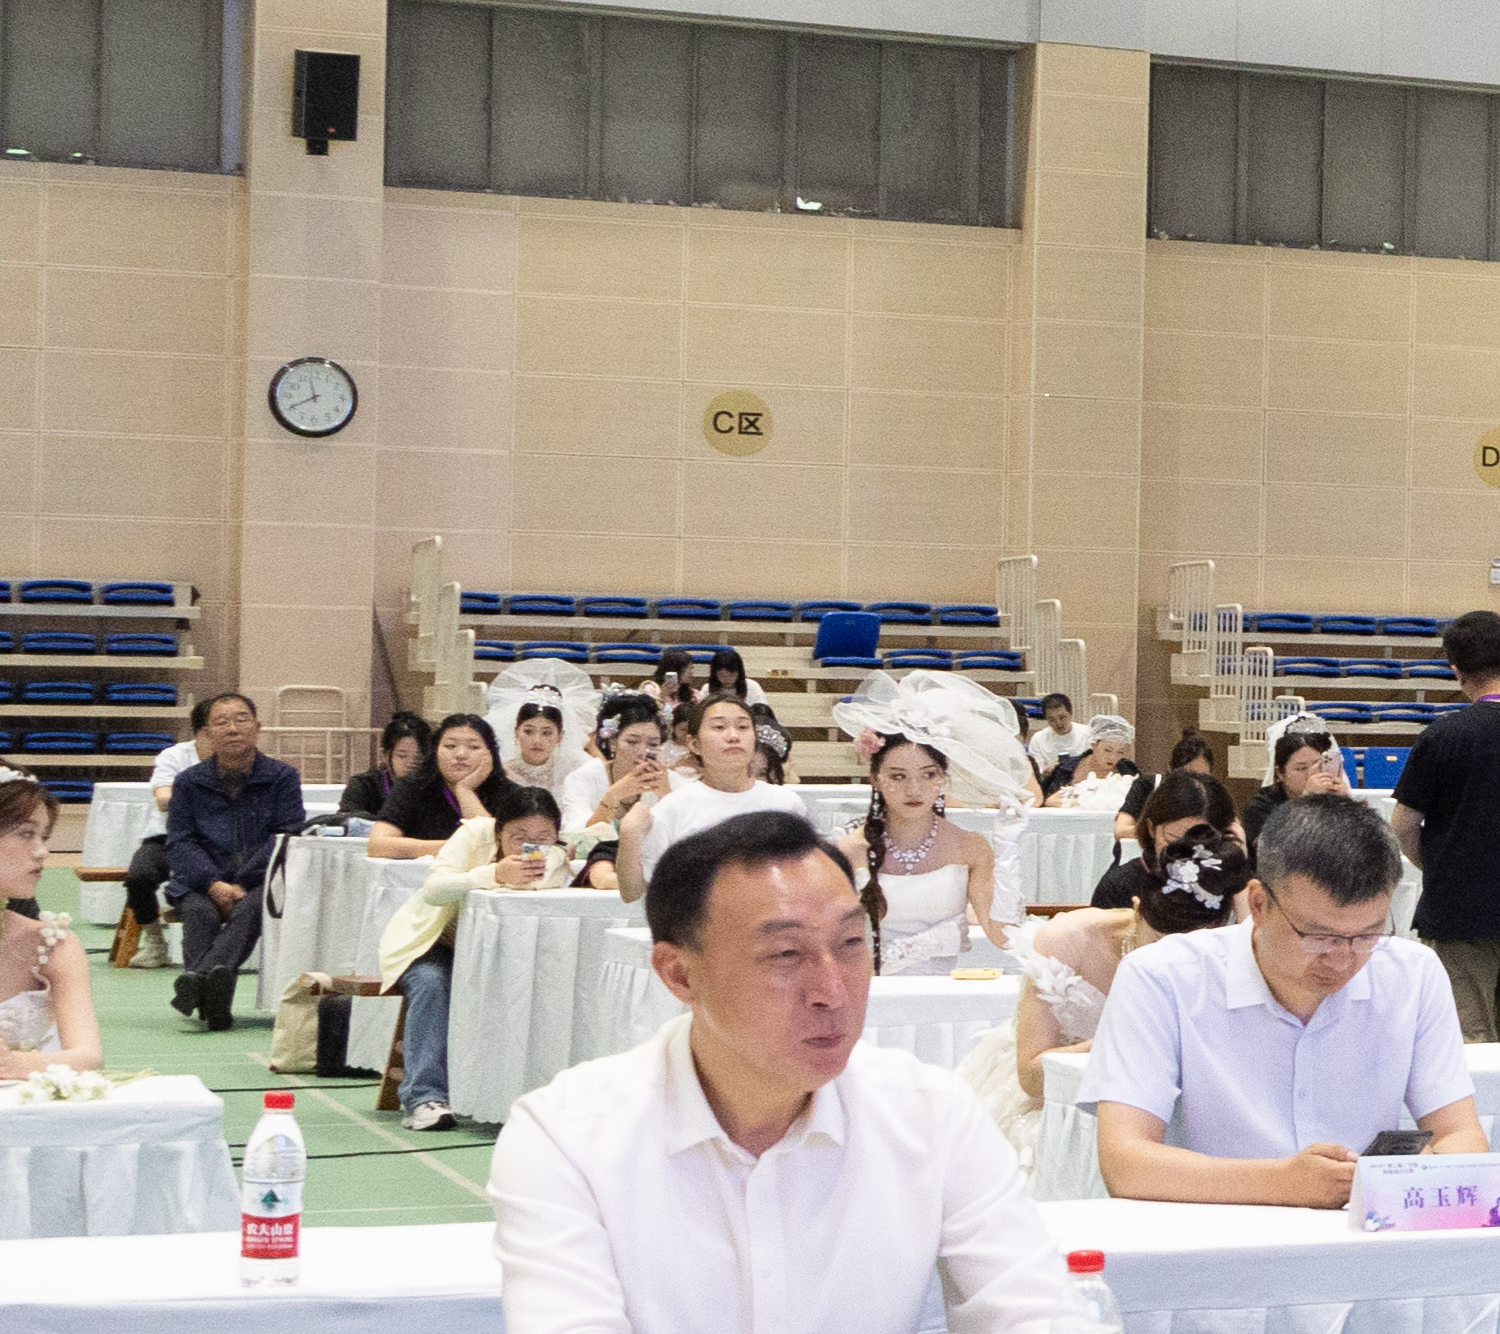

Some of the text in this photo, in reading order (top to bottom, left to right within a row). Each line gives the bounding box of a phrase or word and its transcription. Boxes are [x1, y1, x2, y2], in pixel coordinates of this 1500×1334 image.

[712, 410, 764, 436] C区
[1403, 1184, 1479, 1210] 高玉辉
